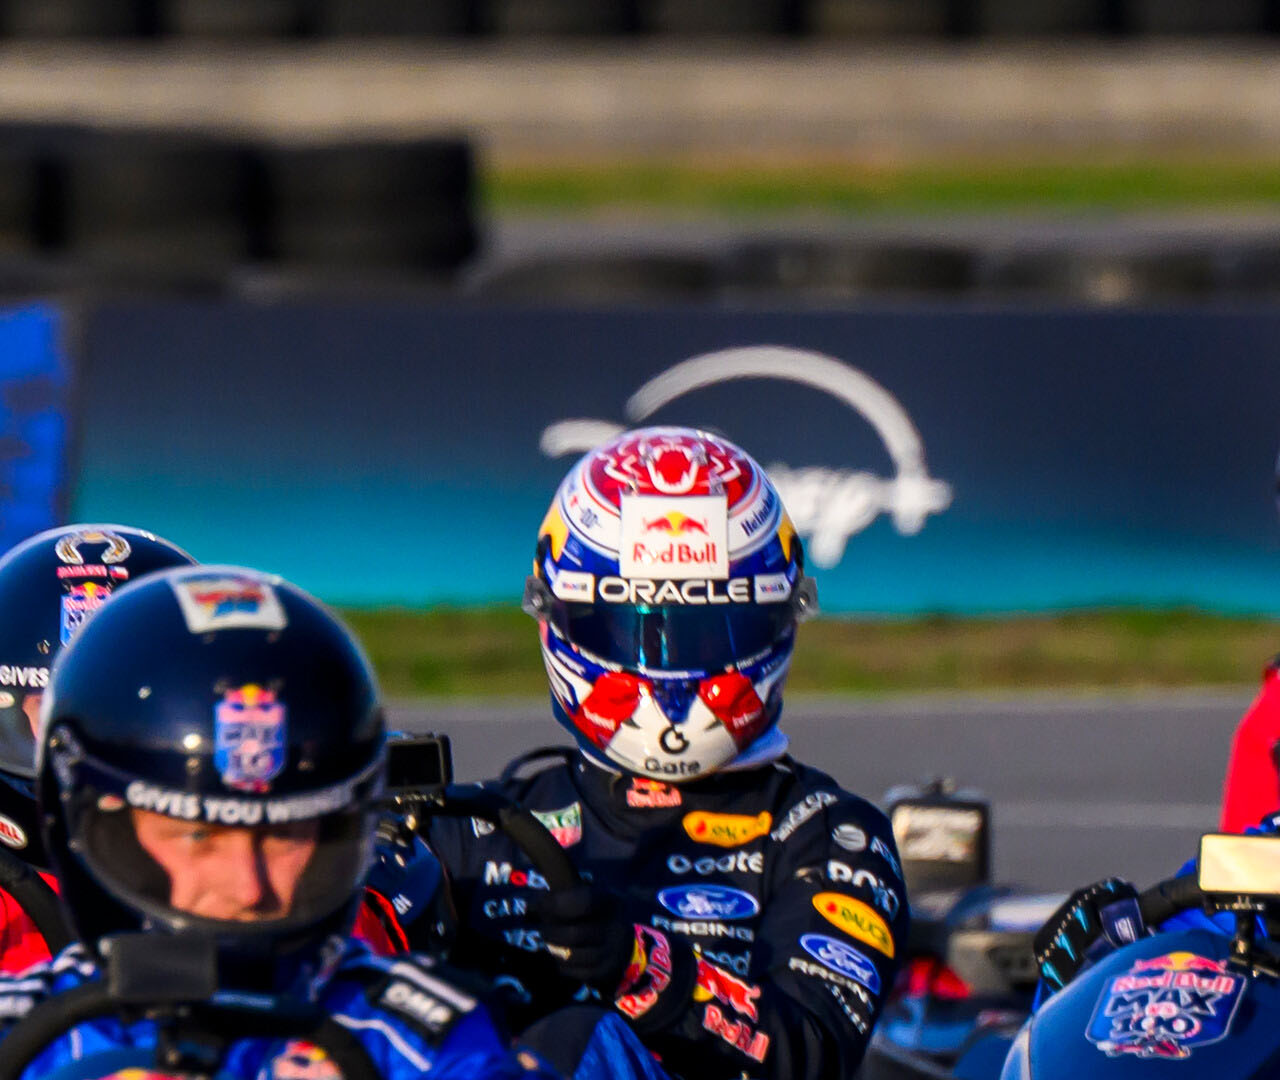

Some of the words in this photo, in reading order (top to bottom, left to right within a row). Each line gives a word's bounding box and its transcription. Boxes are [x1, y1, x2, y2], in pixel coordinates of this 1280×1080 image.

[678, 542, 717, 563] Bull
[598, 576, 750, 604] ORACLE
[203, 799, 263, 825] YOU
[484, 860, 550, 891] Mob
[651, 914, 755, 942] RACING
